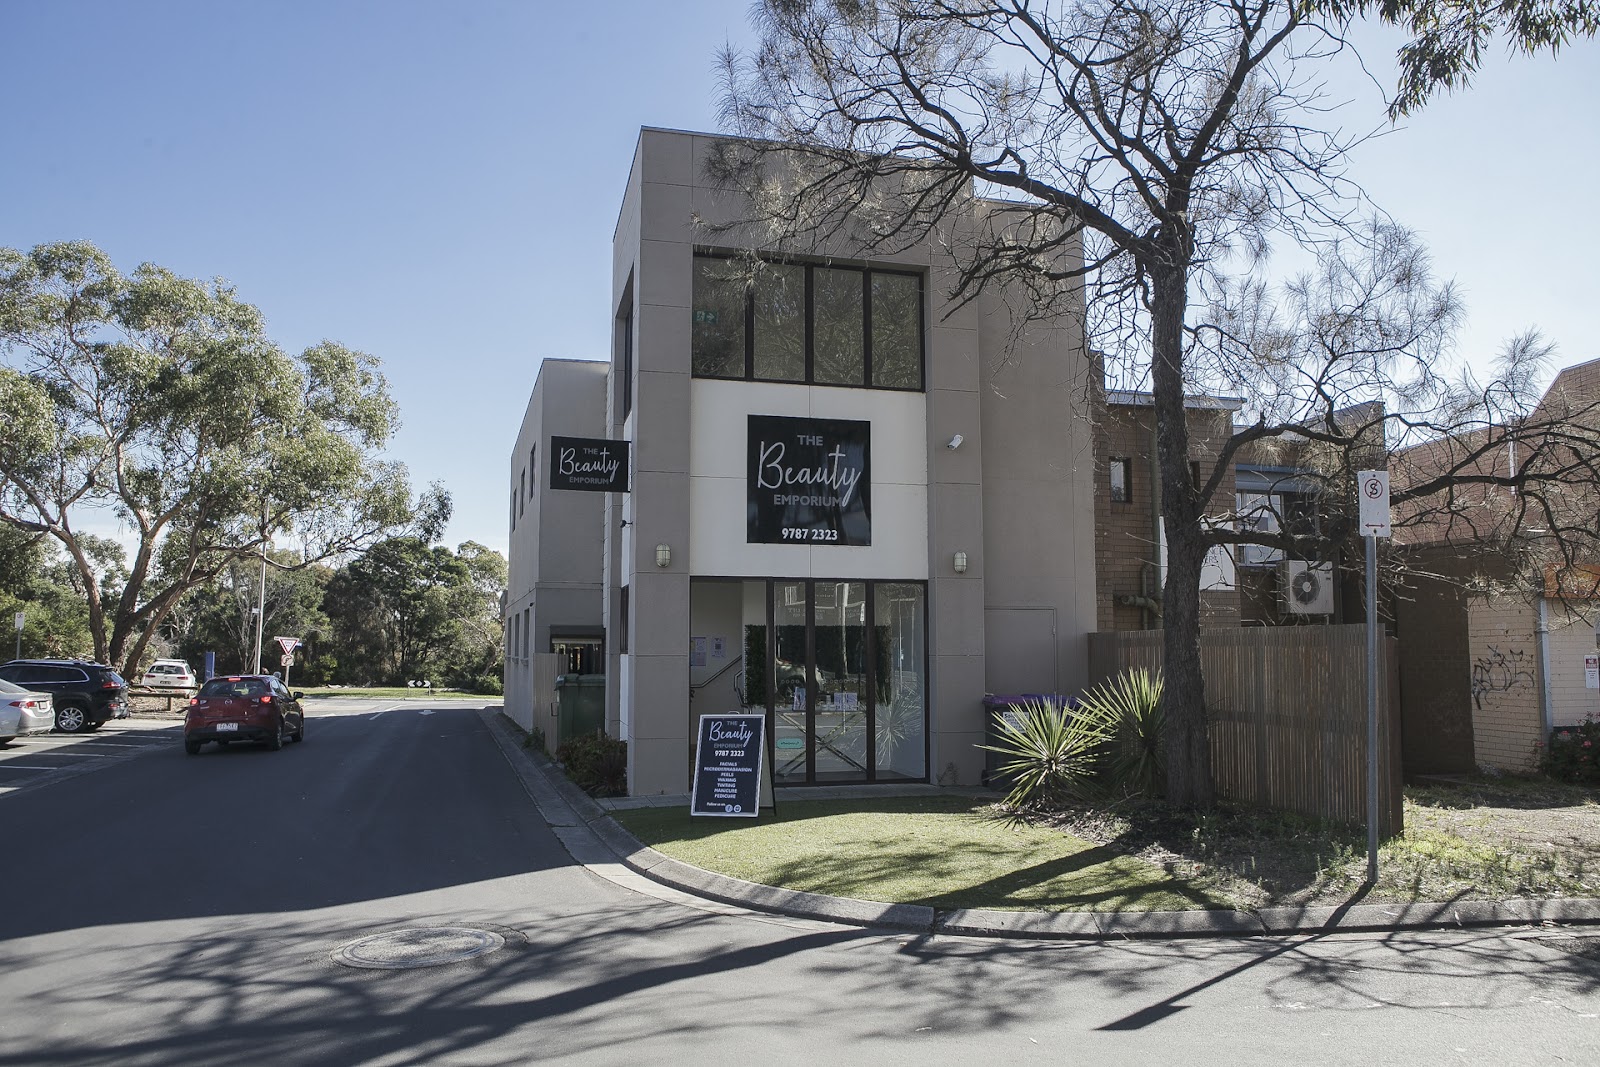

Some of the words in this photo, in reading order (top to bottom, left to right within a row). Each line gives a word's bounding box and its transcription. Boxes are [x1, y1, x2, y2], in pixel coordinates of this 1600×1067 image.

[797, 435, 823, 446] THE
[583, 447, 599, 455] THE
[559, 447, 620, 483] Beauty
[757, 440, 861, 507] Beauty
[569, 476, 609, 485] EMPORIUM
[773, 494, 843, 507] EMPORIUM
[781, 528, 809, 539] 9787
[811, 529, 838, 540] 2323
[709, 721, 753, 748] Beauty
